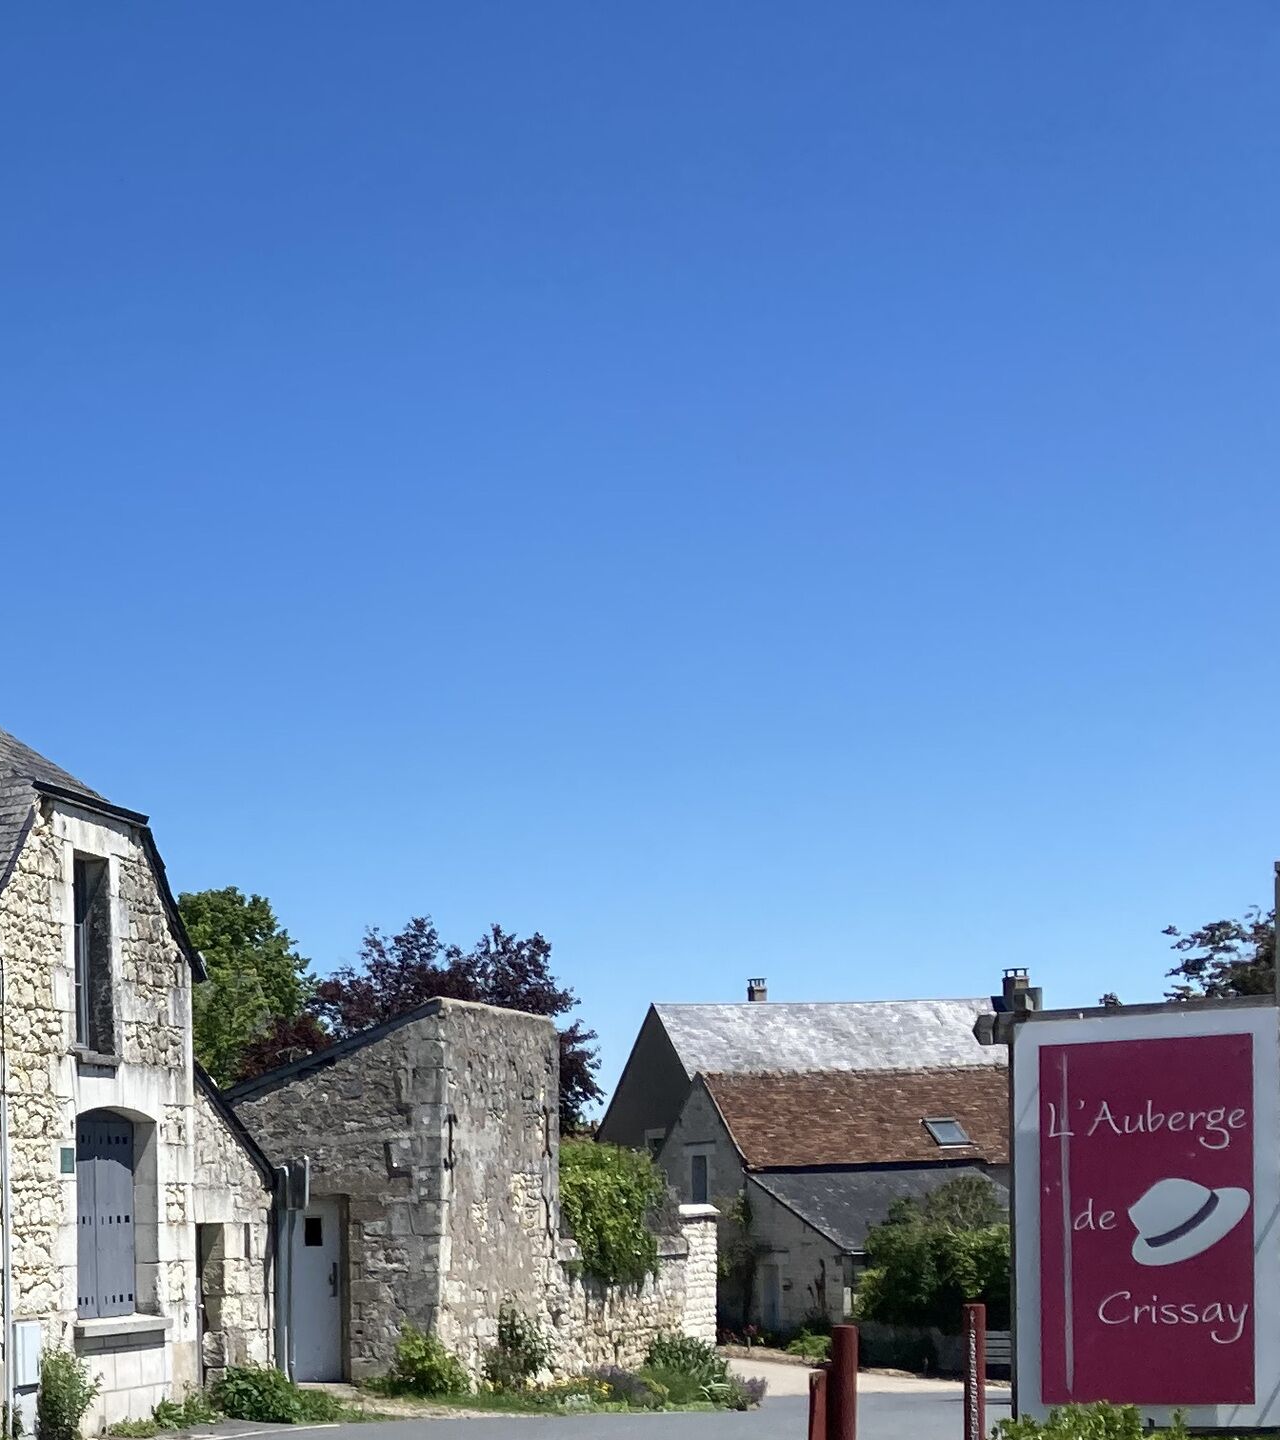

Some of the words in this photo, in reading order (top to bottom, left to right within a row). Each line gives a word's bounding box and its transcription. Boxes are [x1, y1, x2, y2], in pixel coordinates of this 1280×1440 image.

[1047, 1100, 1247, 1150] L'Auberge
[1073, 1198, 1117, 1231] de
[1098, 1291, 1249, 1344] Crissay
